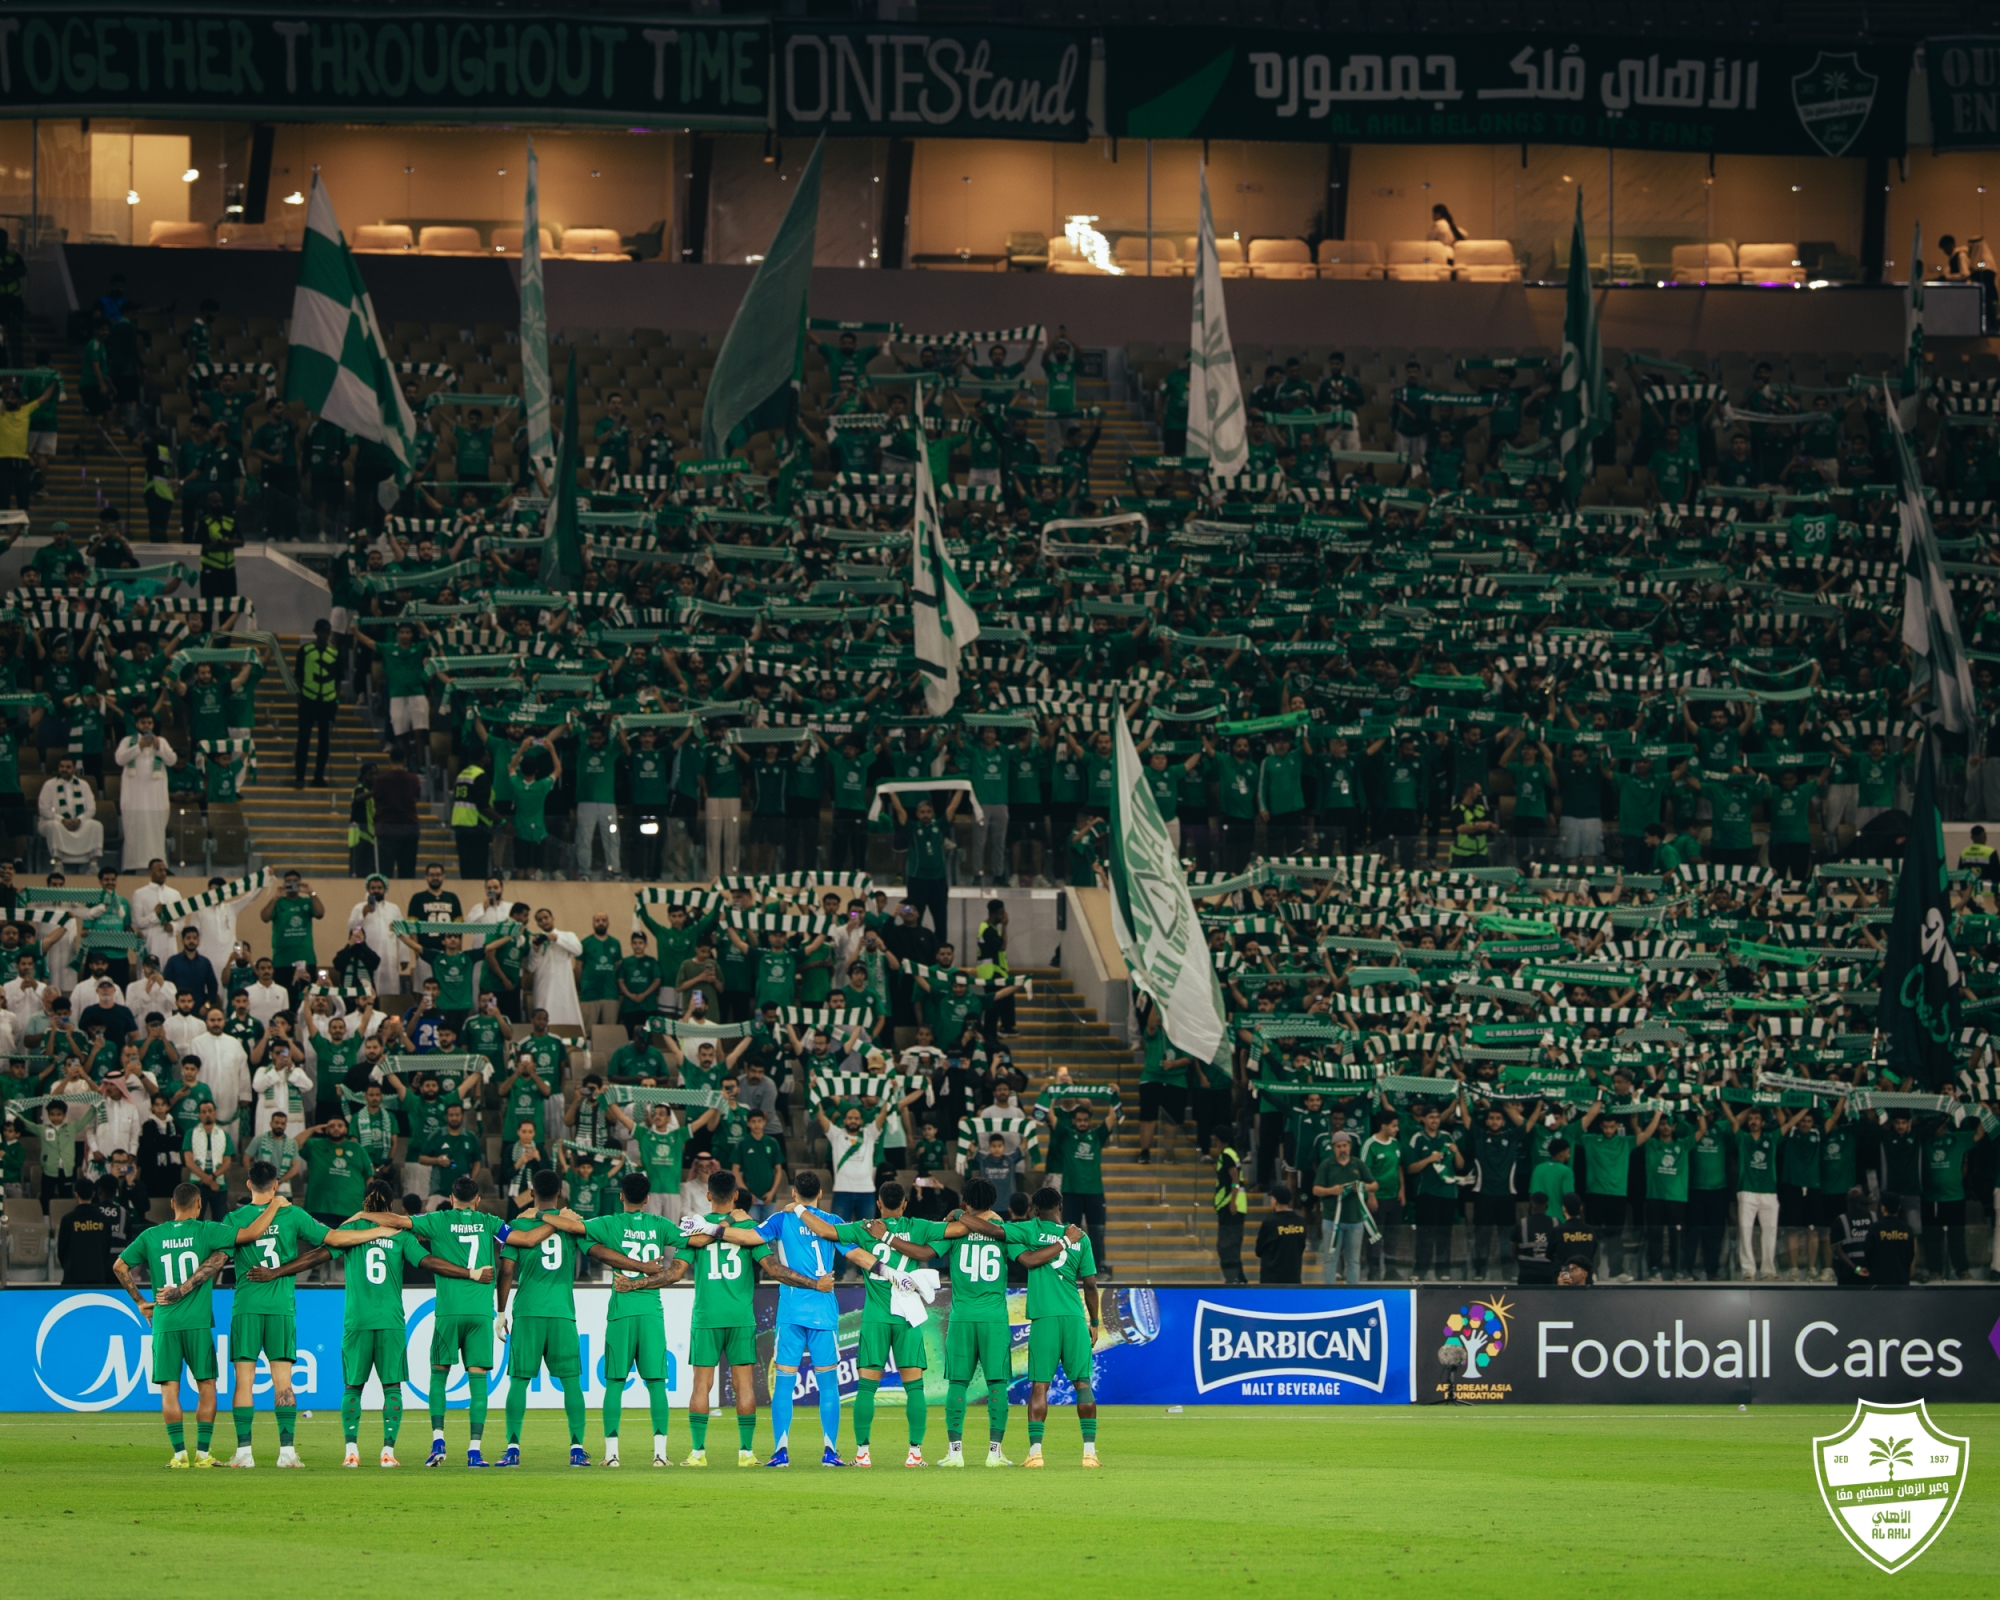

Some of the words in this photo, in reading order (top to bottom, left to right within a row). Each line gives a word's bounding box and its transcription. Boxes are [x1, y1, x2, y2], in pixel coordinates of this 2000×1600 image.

[0, 17, 264, 95] TOGETHER
[273, 21, 628, 97] THROUGHOUT
[643, 28, 763, 104] TIME
[1941, 47, 2000, 88] OU
[1951, 91, 2000, 133] EN
[1430, 113, 1546, 134] BELONGS
[1554, 113, 1586, 136] TO
[1649, 120, 1715, 146] FANS
[1804, 521, 1826, 543] 28
[74, 1220, 104, 1231] Police
[450, 1223, 485, 1233] MAHREZ
[1277, 1224, 1304, 1236] Police
[1534, 1232, 1548, 1243] 36
[1562, 1231, 1594, 1243] Police
[1880, 1229, 1909, 1241] Police
[162, 1236, 194, 1249] MILLOT
[256, 1238, 281, 1270] 3
[459, 1235, 479, 1270] 7
[541, 1233, 562, 1271] 9
[811, 1240, 828, 1278] 1
[160, 1250, 199, 1289] 10
[365, 1247, 387, 1285] 6
[621, 1241, 660, 1278] 30
[706, 1242, 742, 1280] 13
[959, 1243, 1001, 1282] 46
[839, 1331, 860, 1341] ERAGE
[1208, 1327, 1372, 1361] BARBICAN
[1538, 1319, 1770, 1379] Football
[1795, 1320, 1964, 1379] Cares
[1241, 1383, 1273, 1396] MALT
[1278, 1382, 1341, 1396] BEVERAGE
[1436, 1384, 1454, 1392] AF
[1456, 1384, 1489, 1392] DREAM
[1491, 1384, 1512, 1392] ASIA
[1444, 1392, 1504, 1400] FUNDATION
